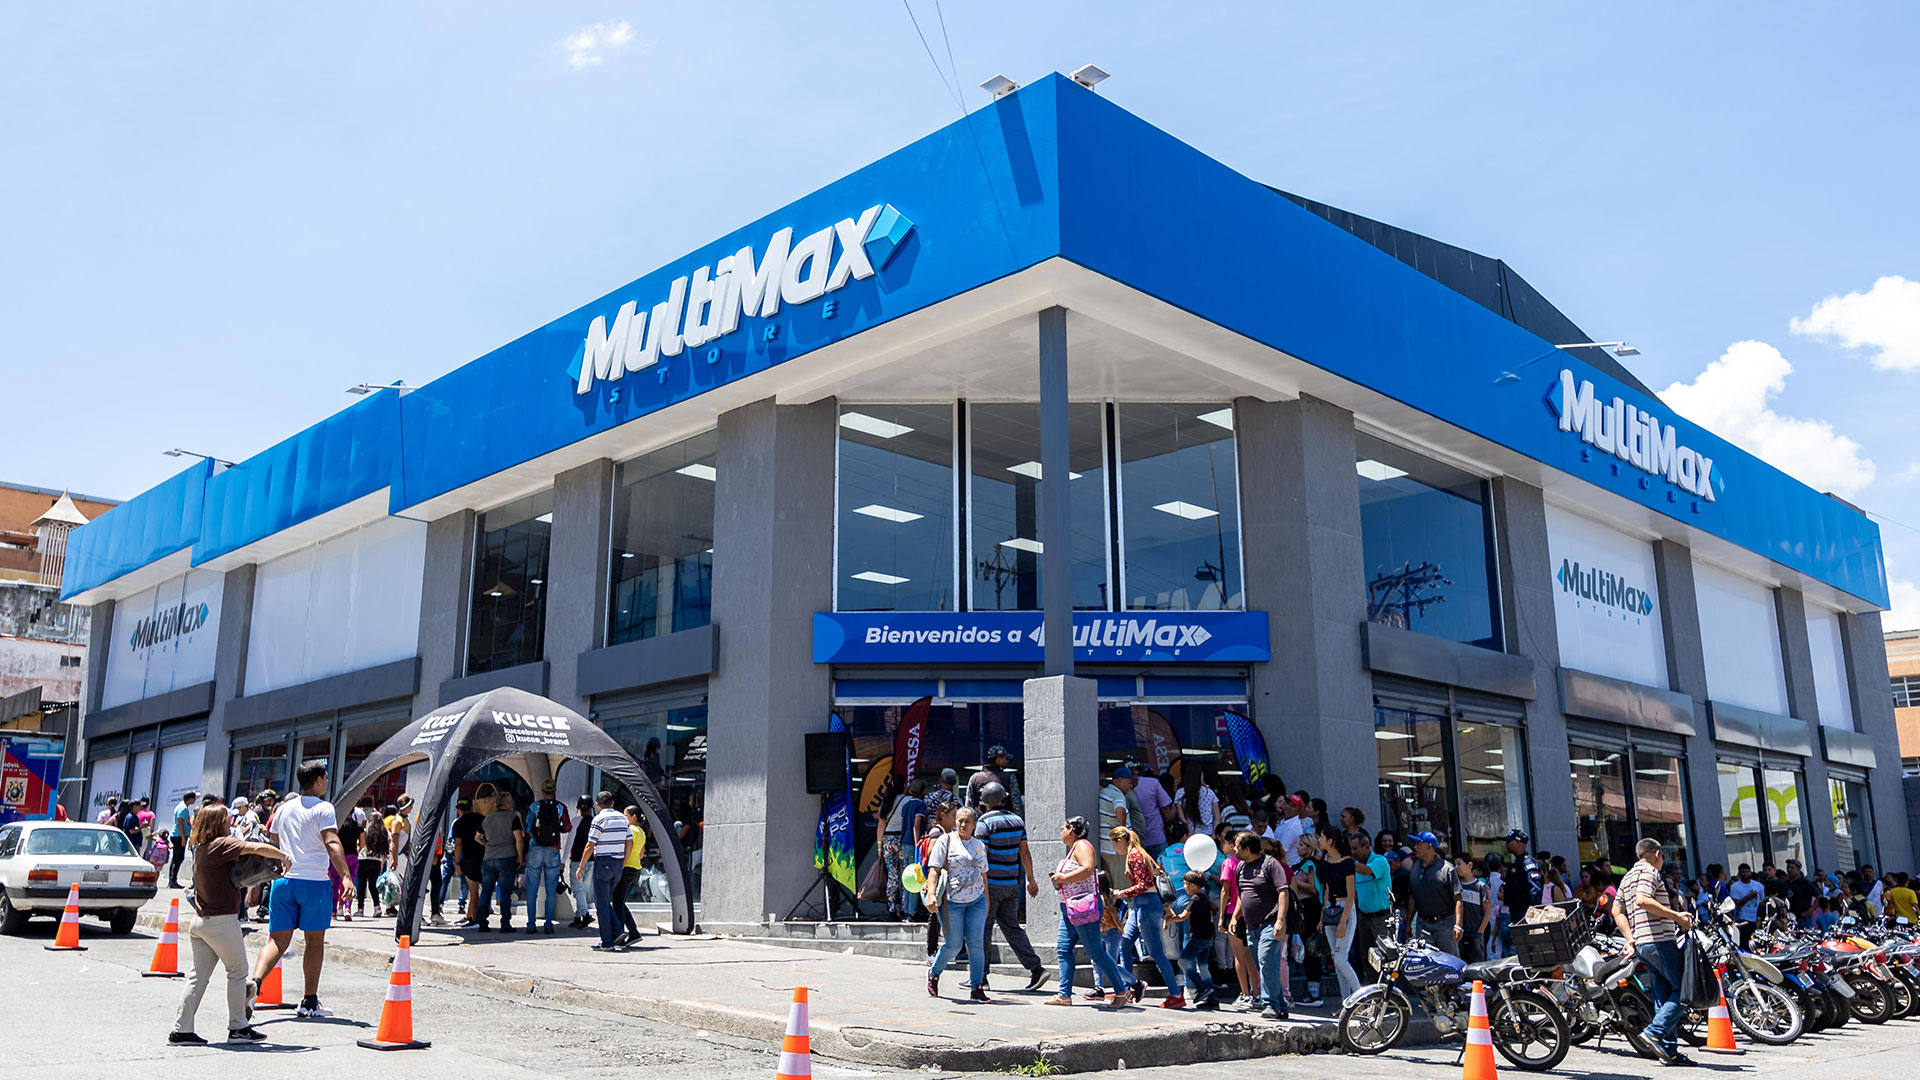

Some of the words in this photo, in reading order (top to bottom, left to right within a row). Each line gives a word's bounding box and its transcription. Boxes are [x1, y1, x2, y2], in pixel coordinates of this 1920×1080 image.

[577, 204, 883, 395] MultiMax
[609, 300, 839, 403] STORE
[1559, 368, 1715, 502] MultiMax
[1581, 449, 1701, 514] STORE
[1563, 558, 1646, 616] MultiMax
[132, 602, 204, 652] MultiMax
[865, 625, 1002, 644] Bienvenidos
[1007, 629, 1022, 643] a
[1037, 619, 1198, 647] ultiMax
[491, 710, 571, 731] KUCCE
[503, 726, 568, 739] kuccebrand.com
[516, 736, 570, 747] kucce_brand
